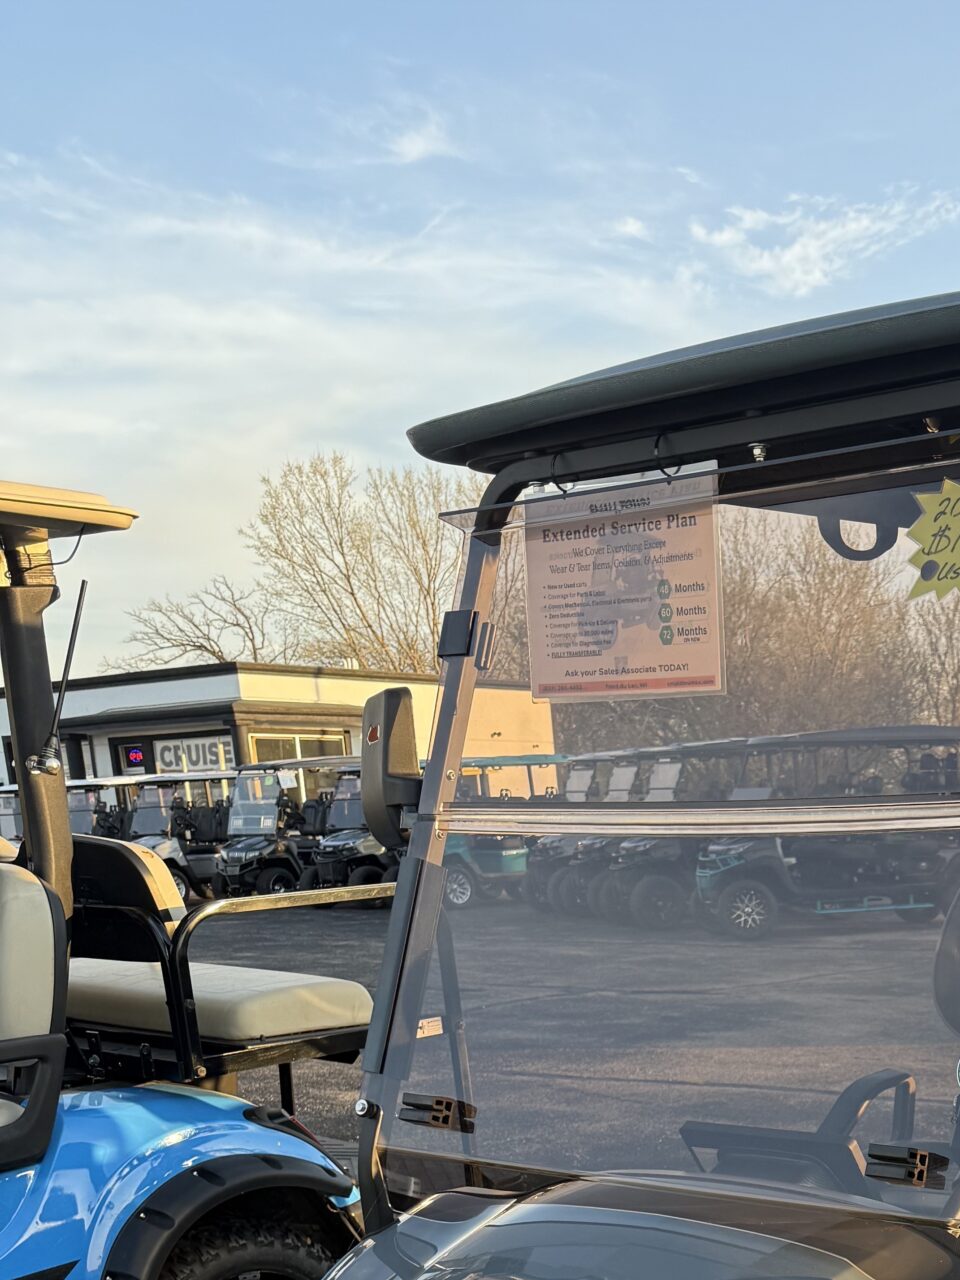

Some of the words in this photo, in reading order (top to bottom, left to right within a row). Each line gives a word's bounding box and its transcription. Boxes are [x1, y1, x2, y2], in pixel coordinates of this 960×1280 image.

[542, 524, 606, 543] Extended
[611, 518, 661, 536] Service
[667, 514, 697, 529] Plan
[572, 548, 584, 557] We
[585, 546, 605, 557] Cover
[606, 542, 643, 555] Everything
[644, 539, 666, 551] Except
[549, 564, 566, 574] Wear
[568, 564, 576, 573] &
[577, 562, 591, 572] Tear
[644, 556, 650, 565] &
[652, 552, 693, 565] Adjustments
[674, 581, 705, 593] Months
[661, 608, 671, 617] 60
[676, 605, 707, 616] Months
[663, 630, 671, 639] 72
[677, 625, 708, 637] Months
[565, 669, 579, 677] Ask
[581, 668, 597, 678] your
[598, 667, 619, 676] Sales
[620, 664, 657, 675] Associate
[658, 663, 689, 672] TODAY!
[160, 741, 233, 768] CRUISE
